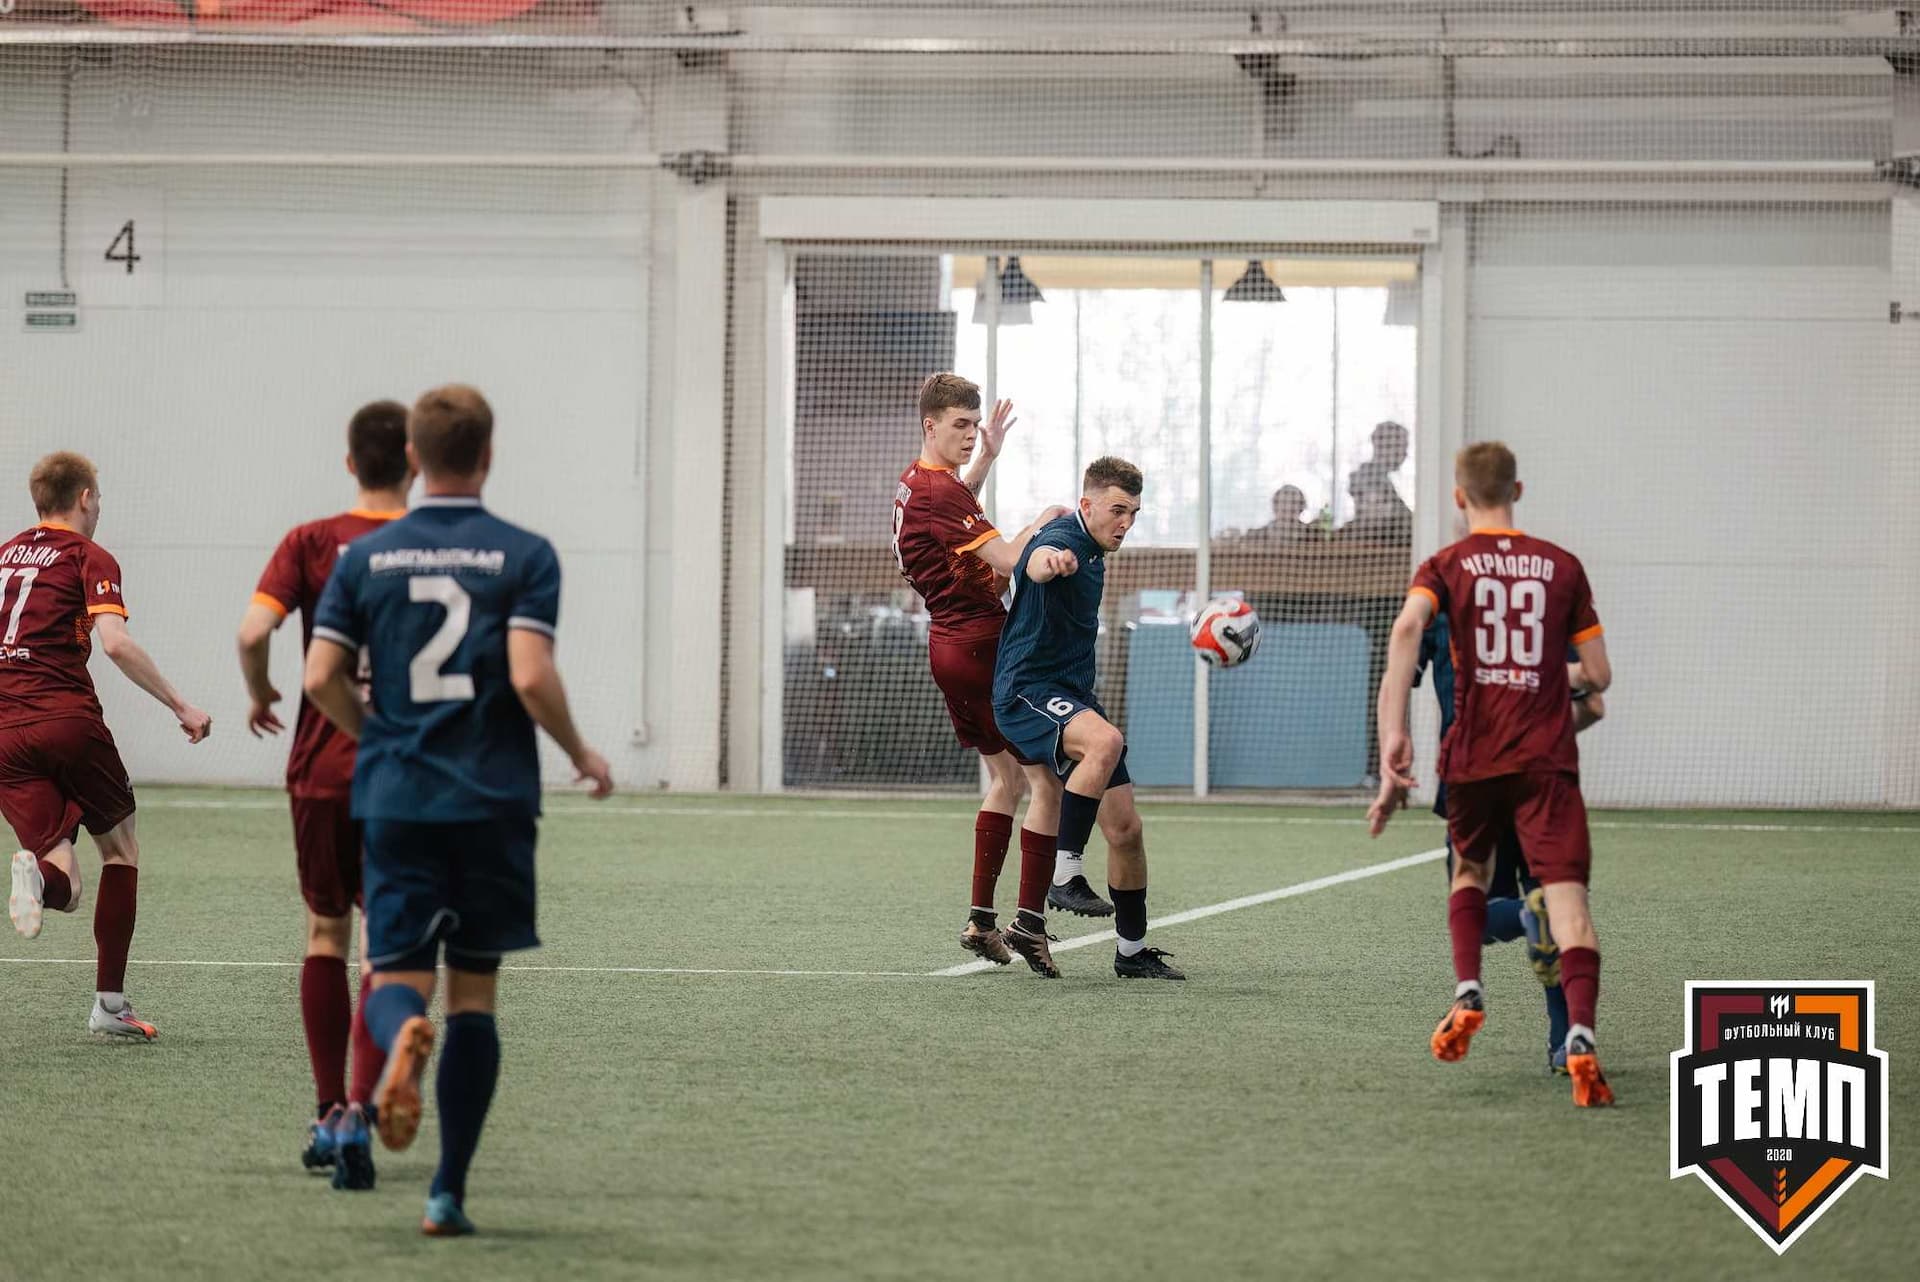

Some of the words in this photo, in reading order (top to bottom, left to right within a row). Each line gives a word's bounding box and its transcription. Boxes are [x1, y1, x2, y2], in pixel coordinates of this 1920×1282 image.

[105, 219, 140, 273] 4
[1461, 553, 1555, 582] ЧЕРКАСОВ
[409, 575, 475, 703] 2
[1474, 576, 1546, 666] 33
[1475, 667, 1540, 687] SEUS
[1046, 696, 1074, 717] 6
